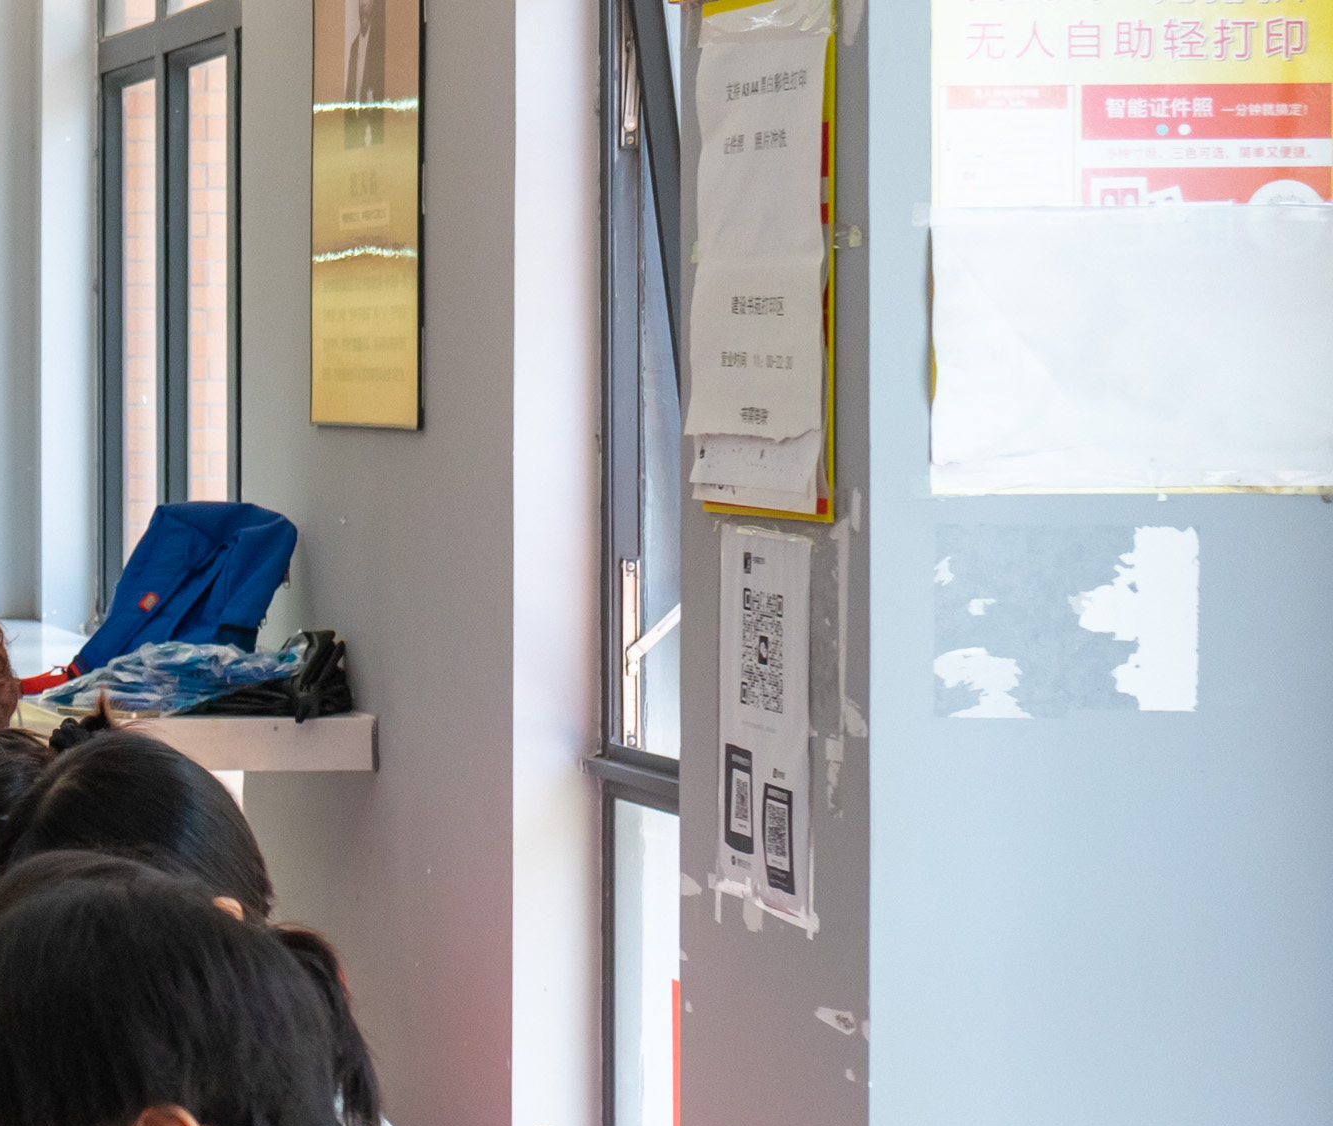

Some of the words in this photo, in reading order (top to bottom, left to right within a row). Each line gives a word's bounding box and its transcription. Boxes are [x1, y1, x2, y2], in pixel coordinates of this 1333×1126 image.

[966, 17, 1307, 60] 无人自助轻打印
[1105, 97, 1214, 119] 智能证件照
